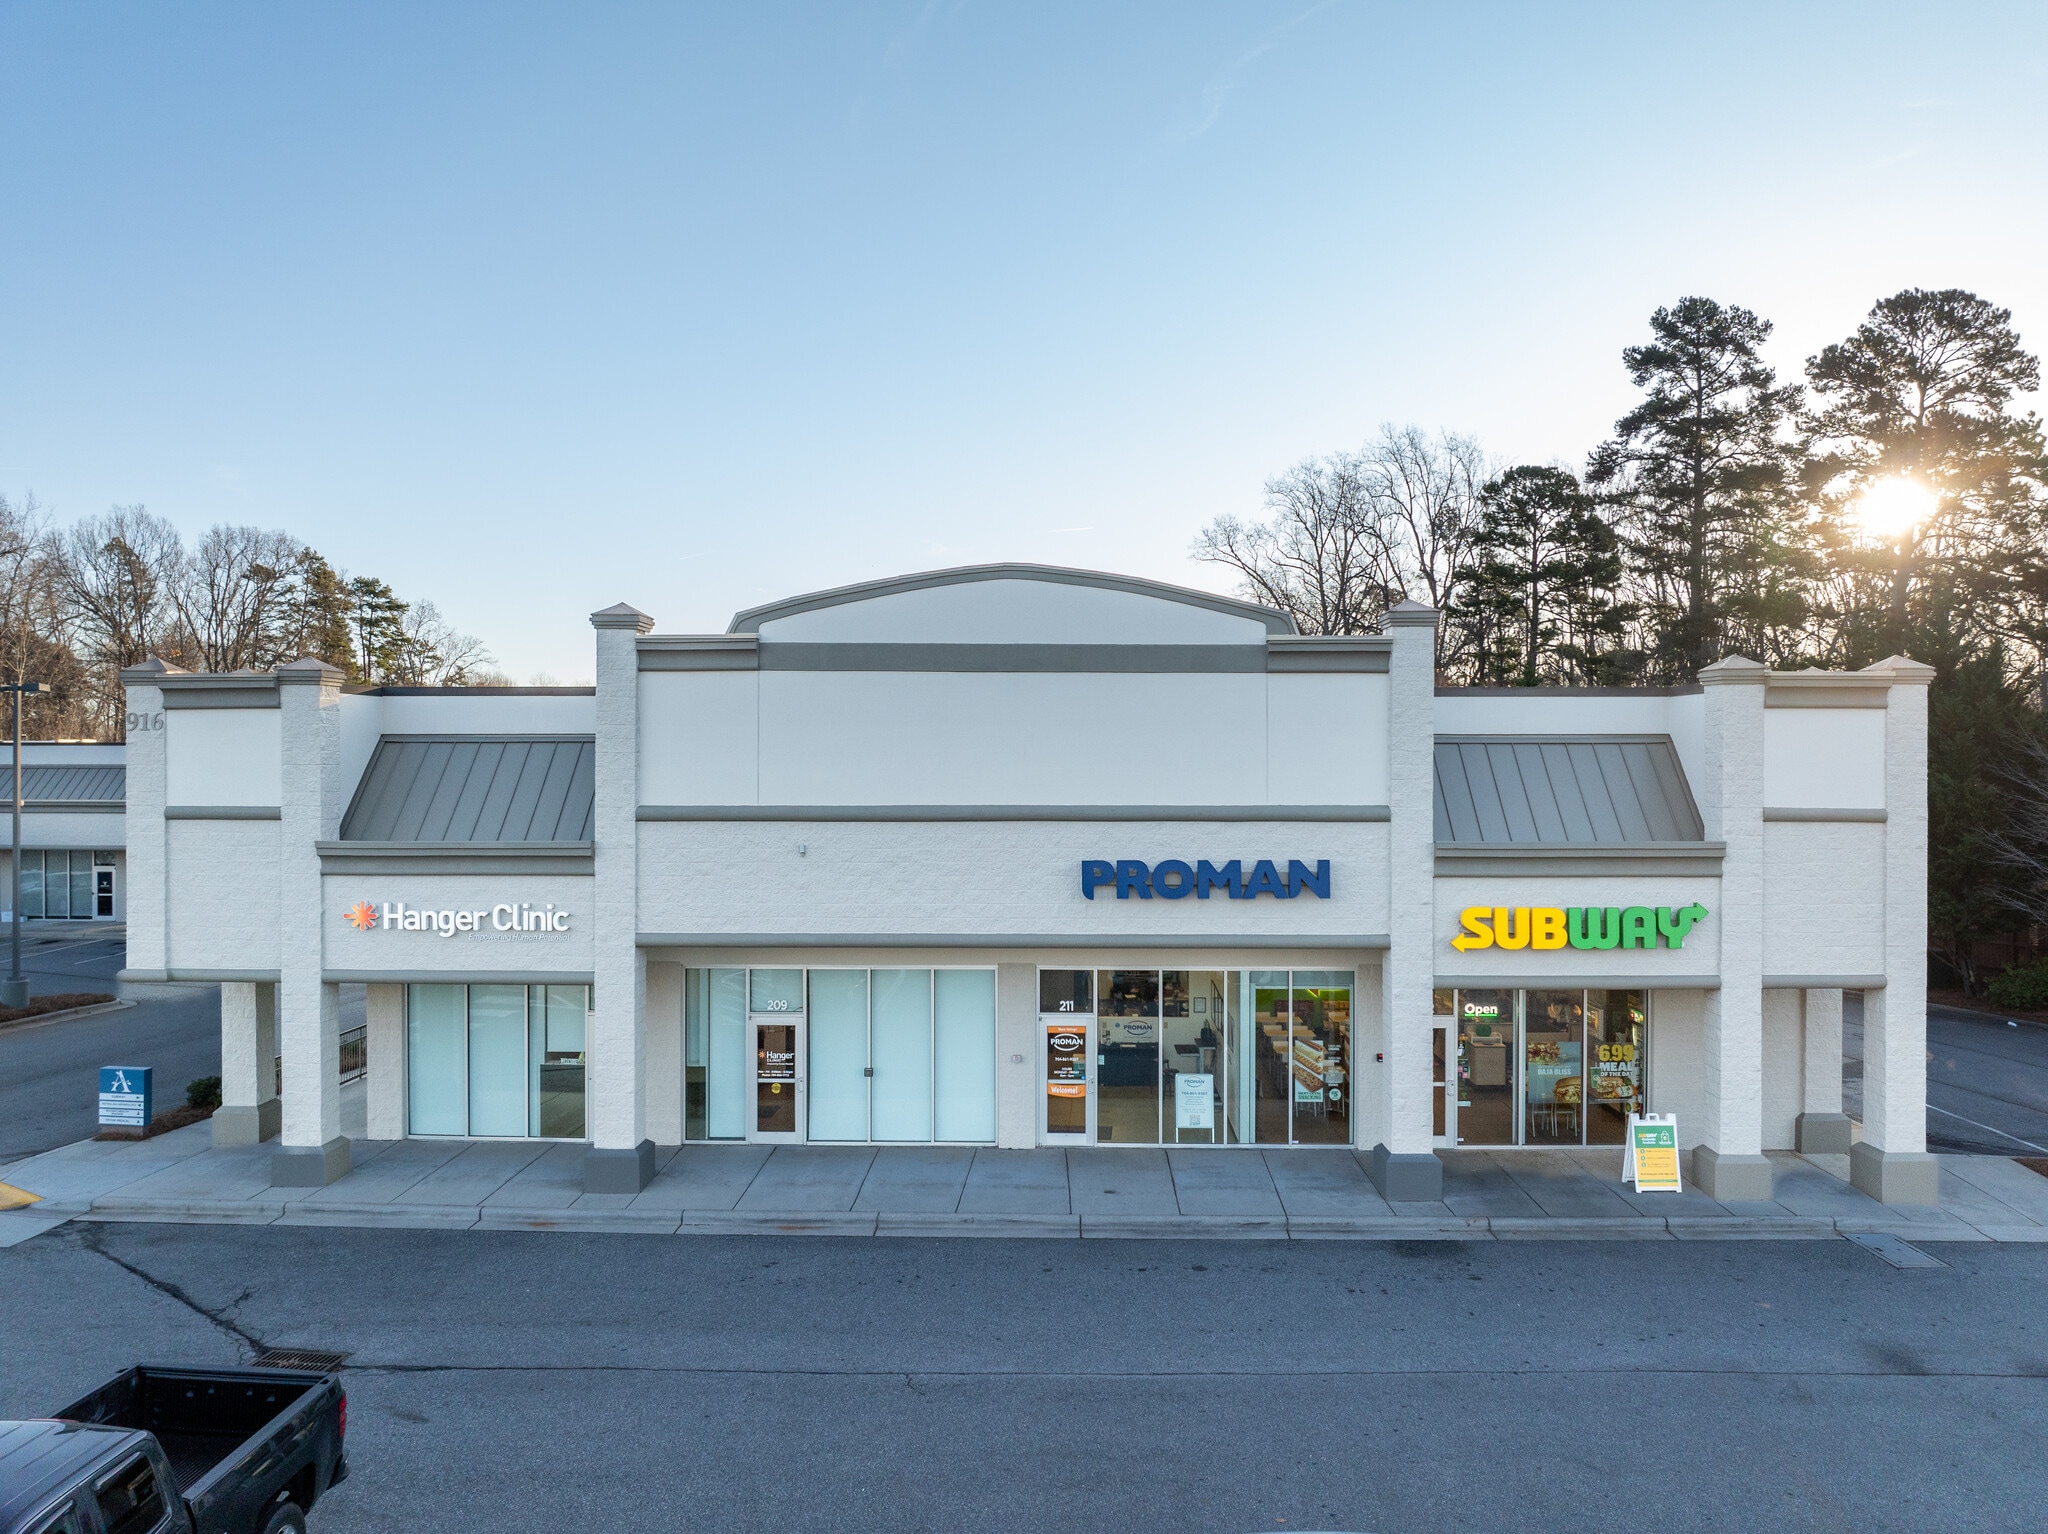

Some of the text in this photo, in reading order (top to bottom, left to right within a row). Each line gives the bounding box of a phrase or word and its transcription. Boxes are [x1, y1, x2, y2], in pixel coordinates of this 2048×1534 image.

[126, 712, 164, 731] 916
[1081, 859, 1331, 900] PROMAN
[383, 902, 570, 938] Hanger Clinic
[1450, 901, 1709, 954] SUBWAY
[468, 933, 512, 942] Empowering
[512, 933, 537, 941] Human
[767, 1000, 788, 1010] 209
[1059, 1000, 1074, 1011] 211
[1464, 1003, 1498, 1017] Open
[766, 1051, 795, 1061] Hanger
[1599, 1044, 1634, 1062] 6.99
[1600, 1062, 1632, 1072] MEAL
[1051, 1086, 1078, 1094] Welcome!
